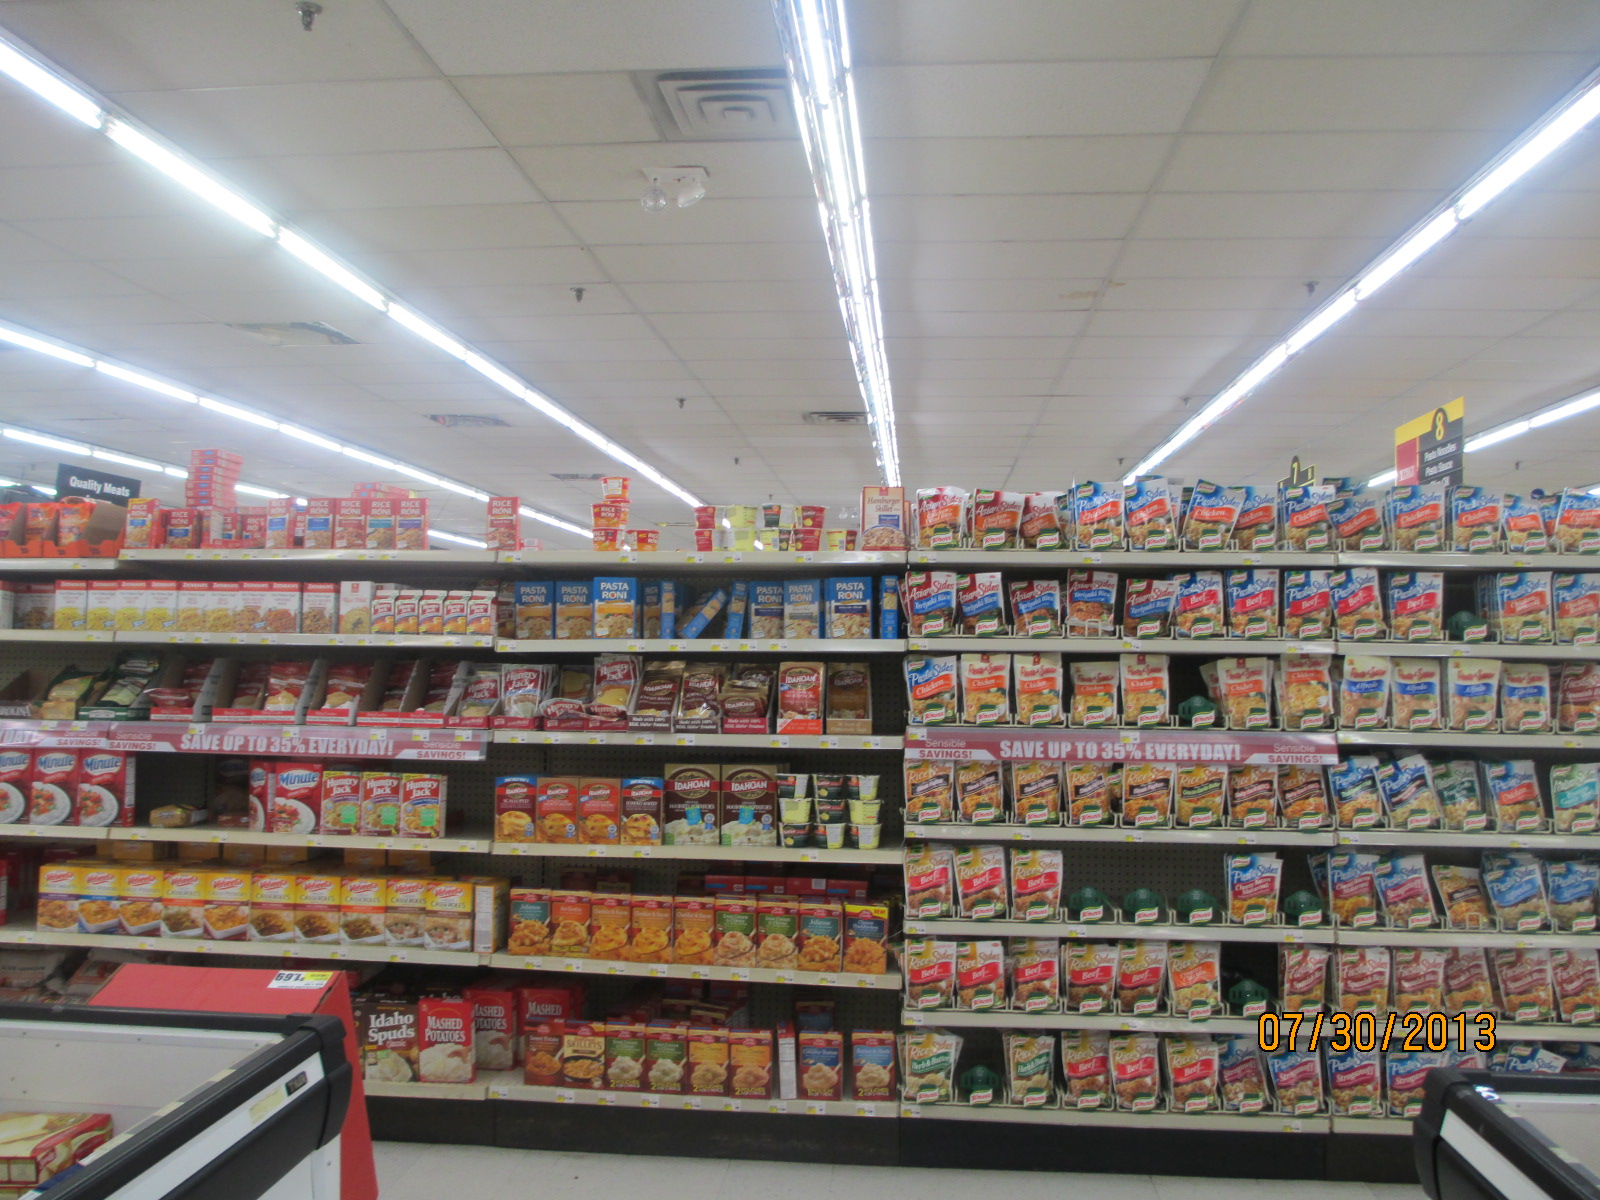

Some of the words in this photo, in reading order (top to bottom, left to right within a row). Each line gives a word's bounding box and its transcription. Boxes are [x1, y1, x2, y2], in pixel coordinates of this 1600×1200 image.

[1435, 412, 1445, 440] 8
[70, 476, 102, 493] Quality
[104, 482, 130, 497] Meats
[270, 498, 286, 507] RICE
[342, 500, 360, 508] RICE
[867, 497, 900, 507] Hamburger
[520, 586, 546, 594] PASTA
[562, 586, 588, 594] PASTA
[600, 582, 629, 591] PASTA
[756, 586, 783, 594] PASTA
[789, 585, 813, 593] PASTA
[836, 582, 864, 591] PASTA
[522, 594, 545, 603] RONI
[563, 594, 586, 603] RONI
[602, 590, 627, 600] RONI
[758, 594, 781, 603] RONI
[790, 593, 812, 602] RONI
[838, 591, 862, 600] RONI
[1246, 595, 1263, 606] Beef
[600, 663, 629, 675] Hungry
[506, 672, 537, 682] Hungry
[786, 675, 817, 683] IDAHOAN
[512, 680, 530, 689] Jack
[644, 683, 673, 692] IDAHOAN
[116, 732, 152, 740] Sensible
[56, 738, 101, 746] SAVINGS!
[109, 741, 156, 750] SAVINGS!
[181, 734, 219, 750] SAVE
[223, 735, 245, 751] UP
[248, 736, 267, 752] TO
[270, 737, 306, 753] 35%
[309, 737, 394, 756] EVERYDAY!
[423, 741, 461, 749] Sensible
[925, 739, 966, 748] Sensible
[1000, 741, 1045, 758] SAVE
[1048, 741, 1071, 758] UP
[1075, 742, 1098, 759] TO
[1101, 742, 1142, 759] 35%
[1146, 743, 1241, 760] EVERYDAY!
[1273, 744, 1315, 752] Sensible
[417, 751, 466, 759] SAVINGS!
[919, 750, 972, 759] SAVINGS!
[1268, 755, 1323, 763] SAVINGS!
[38, 755, 76, 769] Minute
[84, 757, 122, 770] Minute
[279, 772, 319, 785] Minute
[326, 778, 359, 788] Hungry
[366, 779, 399, 789] Hungry
[406, 780, 438, 790] Hungry
[674, 780, 710, 791] IDAHOAN
[731, 781, 767, 792] IDAHOAN
[332, 785, 352, 795] Jack
[372, 786, 392, 796] Jack
[410, 788, 431, 798] Jack
[921, 873, 937, 885] Beef
[973, 875, 990, 887] Beef
[1027, 876, 1045, 887] Beef
[921, 966, 939, 979] Beef
[972, 968, 988, 979] Beef
[1025, 964, 1042, 975] Beef
[1082, 968, 1100, 979] Beef
[528, 1003, 562, 1015] MASHED
[369, 1011, 414, 1028] Idaho
[427, 1016, 463, 1029] MASHED
[368, 1026, 415, 1046] Spuds
[425, 1029, 466, 1042] POTATOES
